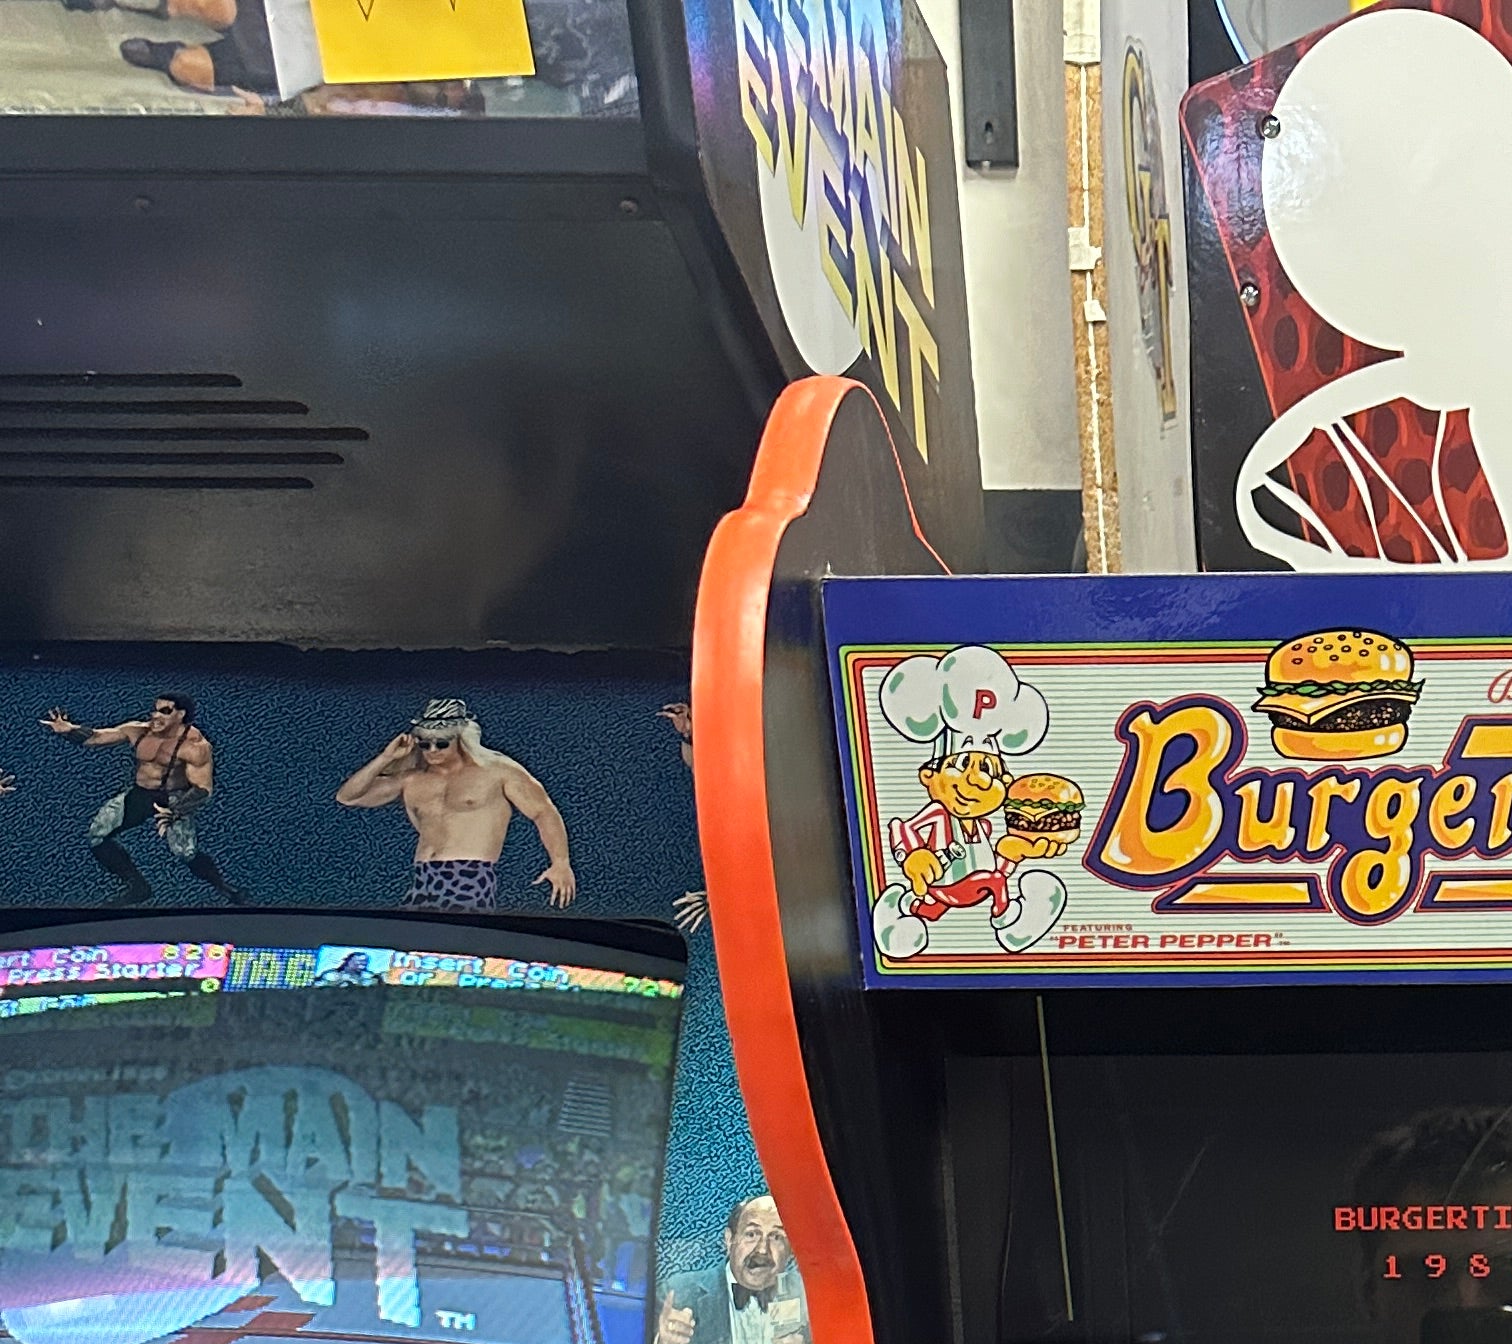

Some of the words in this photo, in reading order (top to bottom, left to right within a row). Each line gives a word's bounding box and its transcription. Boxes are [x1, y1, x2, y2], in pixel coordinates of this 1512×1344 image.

[734, 0, 939, 464] EVENT
[973, 688, 997, 720] P
[1062, 923, 1134, 932] FEATURING
[230, 951, 317, 988] TAG
[0, 1163, 472, 1328] EVENT
